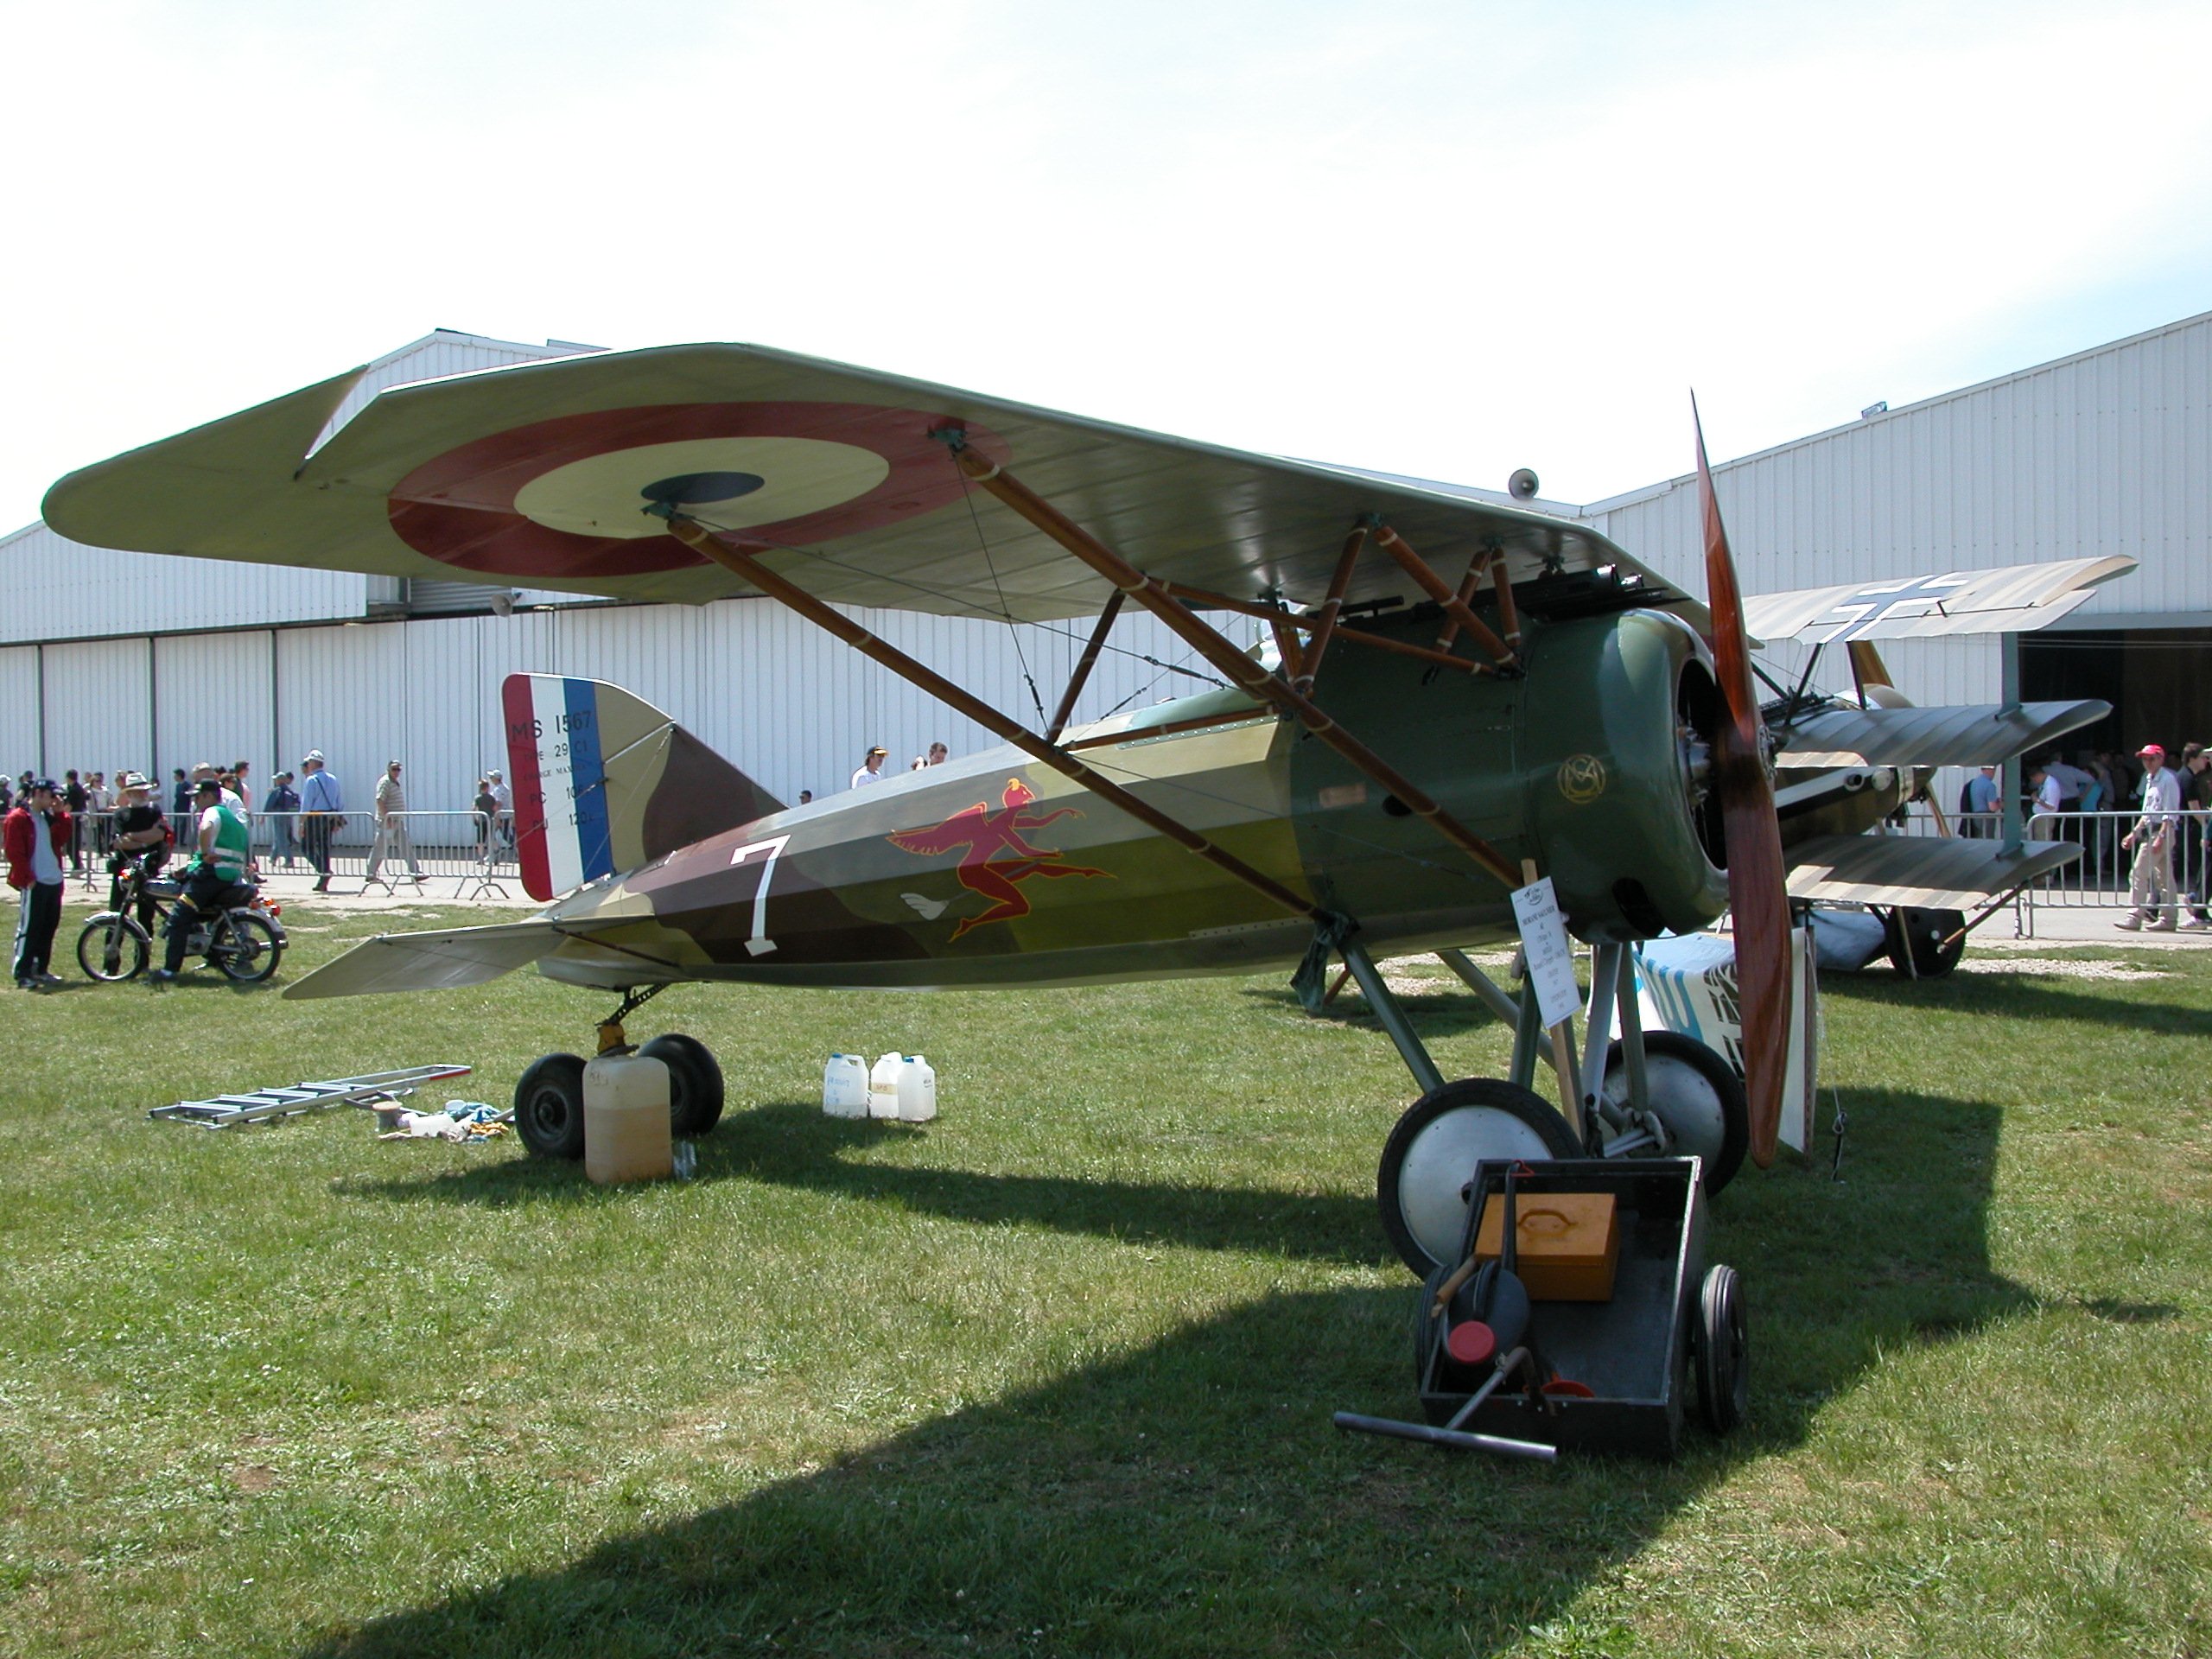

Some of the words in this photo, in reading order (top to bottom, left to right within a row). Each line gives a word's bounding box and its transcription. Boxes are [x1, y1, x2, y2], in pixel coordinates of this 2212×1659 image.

[512, 721, 543, 741] MS
[556, 711, 591, 734] 1567
[555, 743, 568, 757] 29
[730, 834, 791, 957] 7
